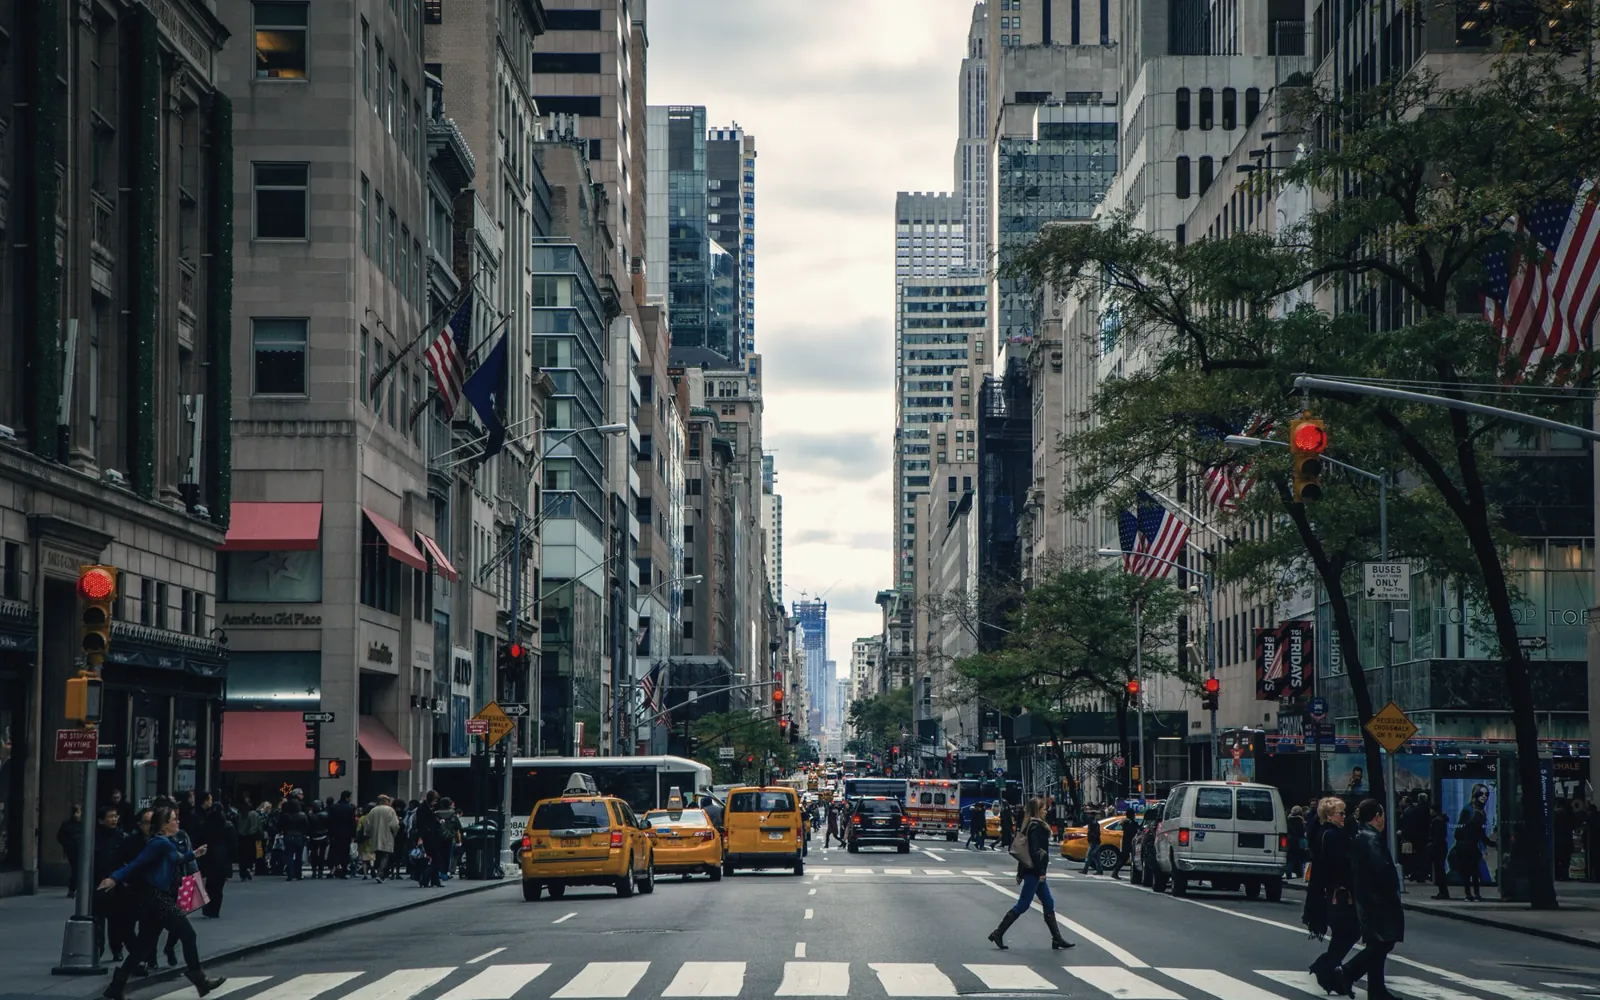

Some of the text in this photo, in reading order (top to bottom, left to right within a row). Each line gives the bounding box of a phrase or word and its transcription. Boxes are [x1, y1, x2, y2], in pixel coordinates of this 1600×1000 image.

[1372, 566, 1402, 574] BUSES
[1376, 578, 1398, 586] ONLY
[222, 612, 322, 625] American Girl Place
[1290, 636, 1302, 688] FRIDAYS
